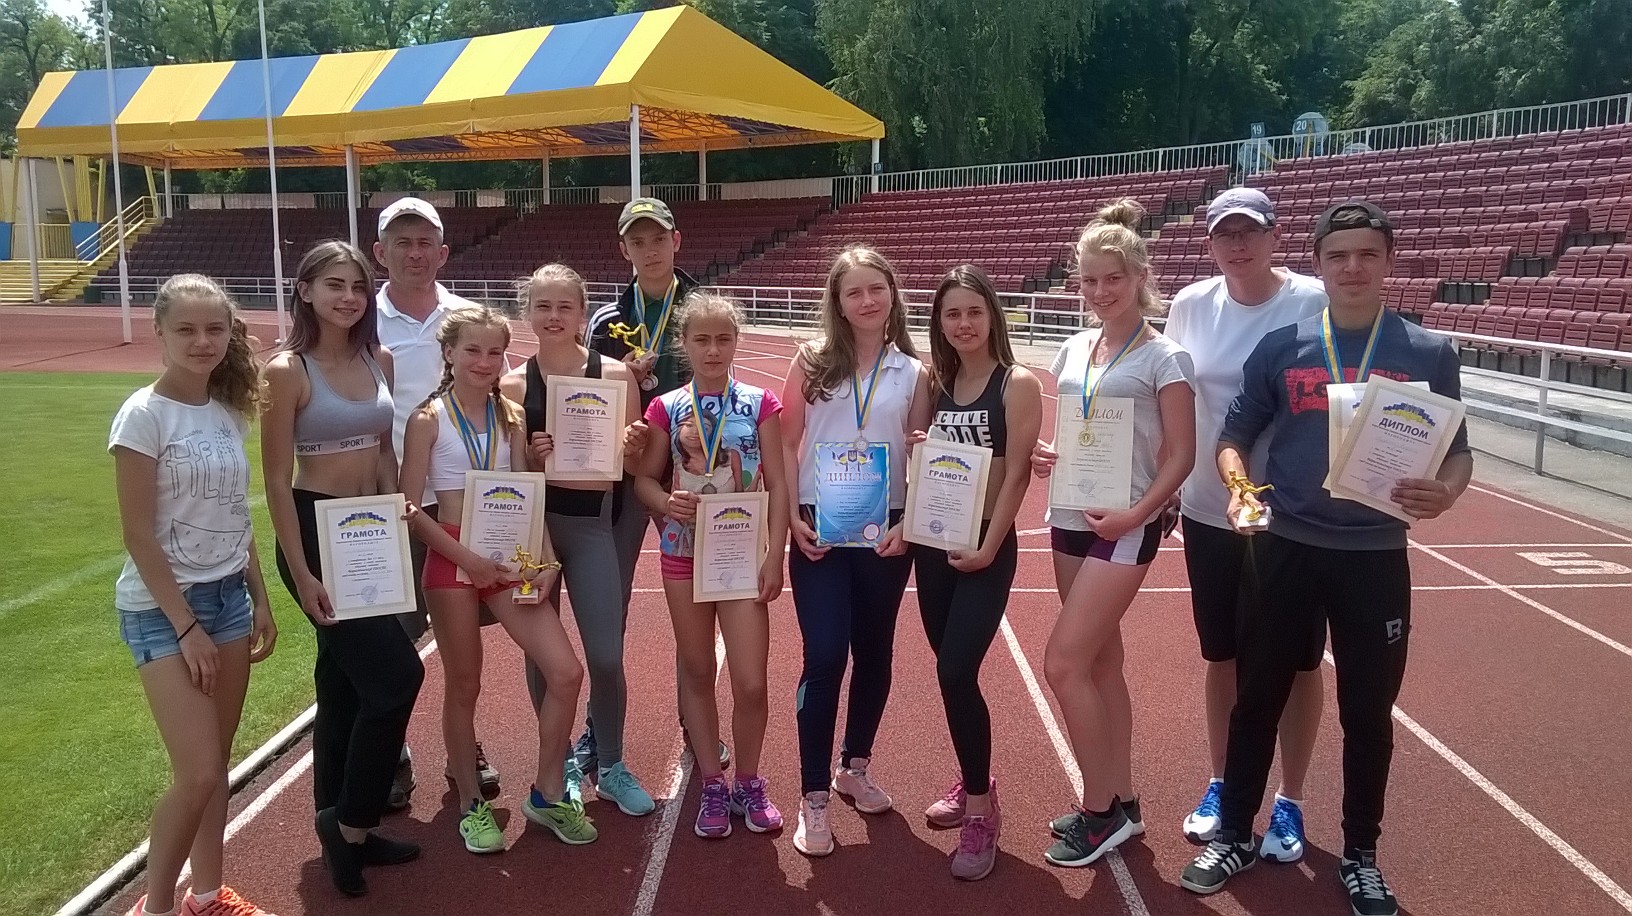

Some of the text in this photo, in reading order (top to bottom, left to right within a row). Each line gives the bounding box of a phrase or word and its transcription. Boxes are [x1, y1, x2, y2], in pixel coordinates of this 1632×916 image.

[1252, 124, 1262, 135] 19
[1295, 119, 1307, 132] 20
[566, 407, 606, 416] ГРАМОТА
[1378, 417, 1429, 440] ДИПЛОМ
[297, 443, 322, 453] SPORT
[340, 437, 364, 449] SPORT
[824, 472, 882, 482] ДИПЛОМ
[929, 469, 969, 482] ГРАМОТА
[483, 502, 523, 511] ГРАМОТА
[713, 522, 750, 530] ГРАМОТА
[340, 528, 387, 540] ГРАМОТА
